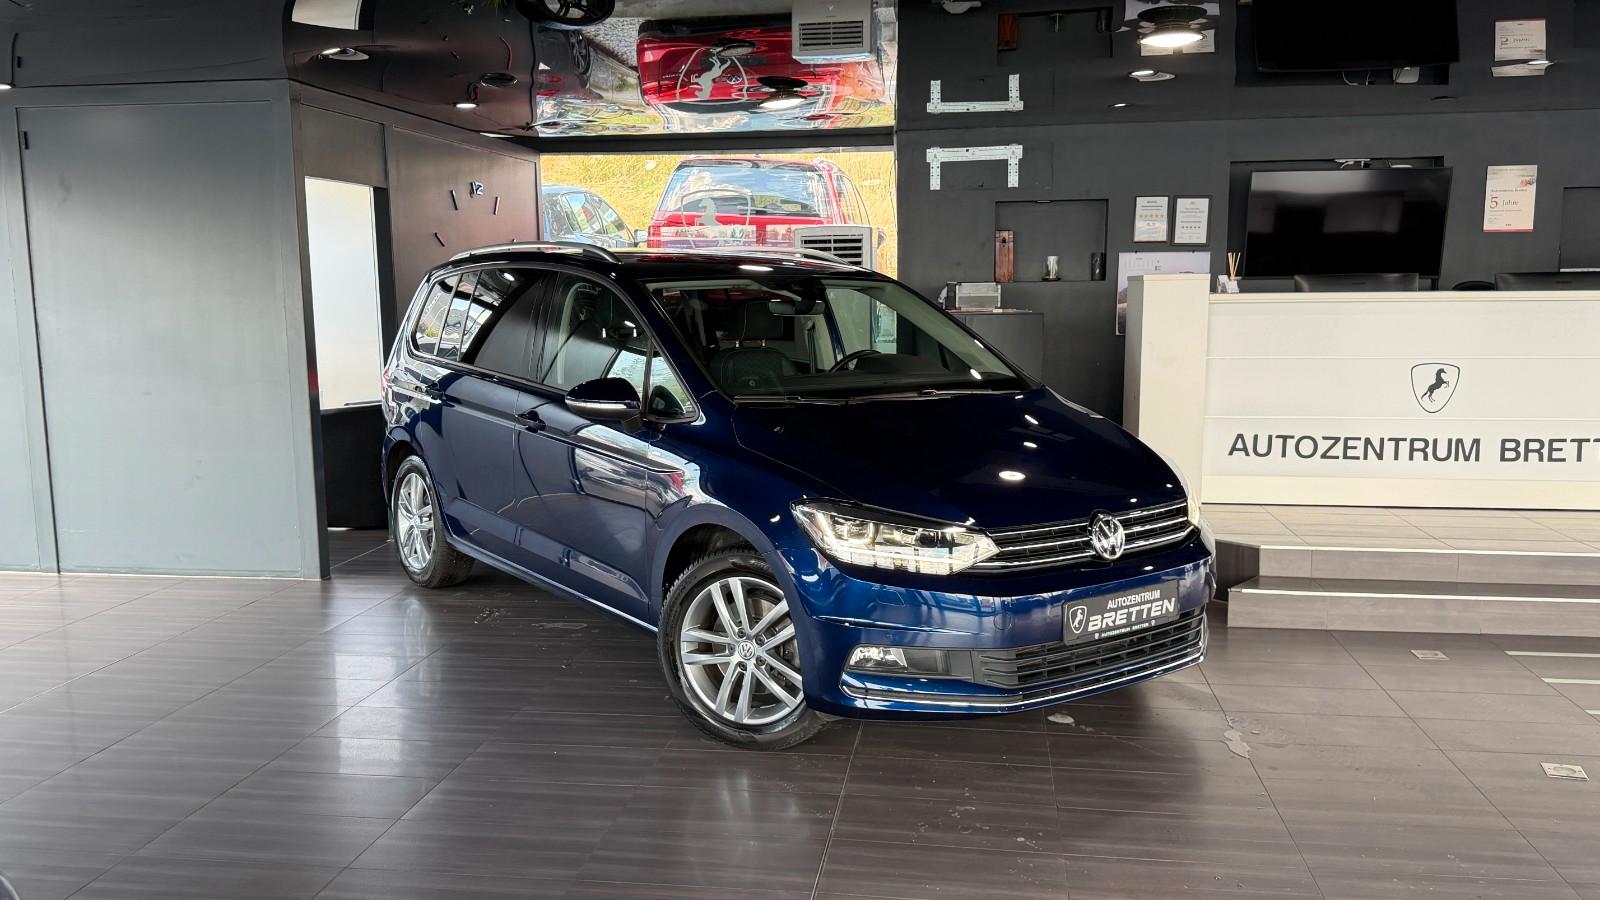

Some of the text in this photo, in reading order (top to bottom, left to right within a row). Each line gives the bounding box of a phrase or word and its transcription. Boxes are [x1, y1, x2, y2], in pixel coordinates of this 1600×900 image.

[1490, 196, 1498, 209] 5
[1228, 433, 1600, 462] AUTOZENTRUM BRET
[1107, 590, 1161, 609] AUTOZENTRUM
[1087, 597, 1176, 632] BRETTEN
